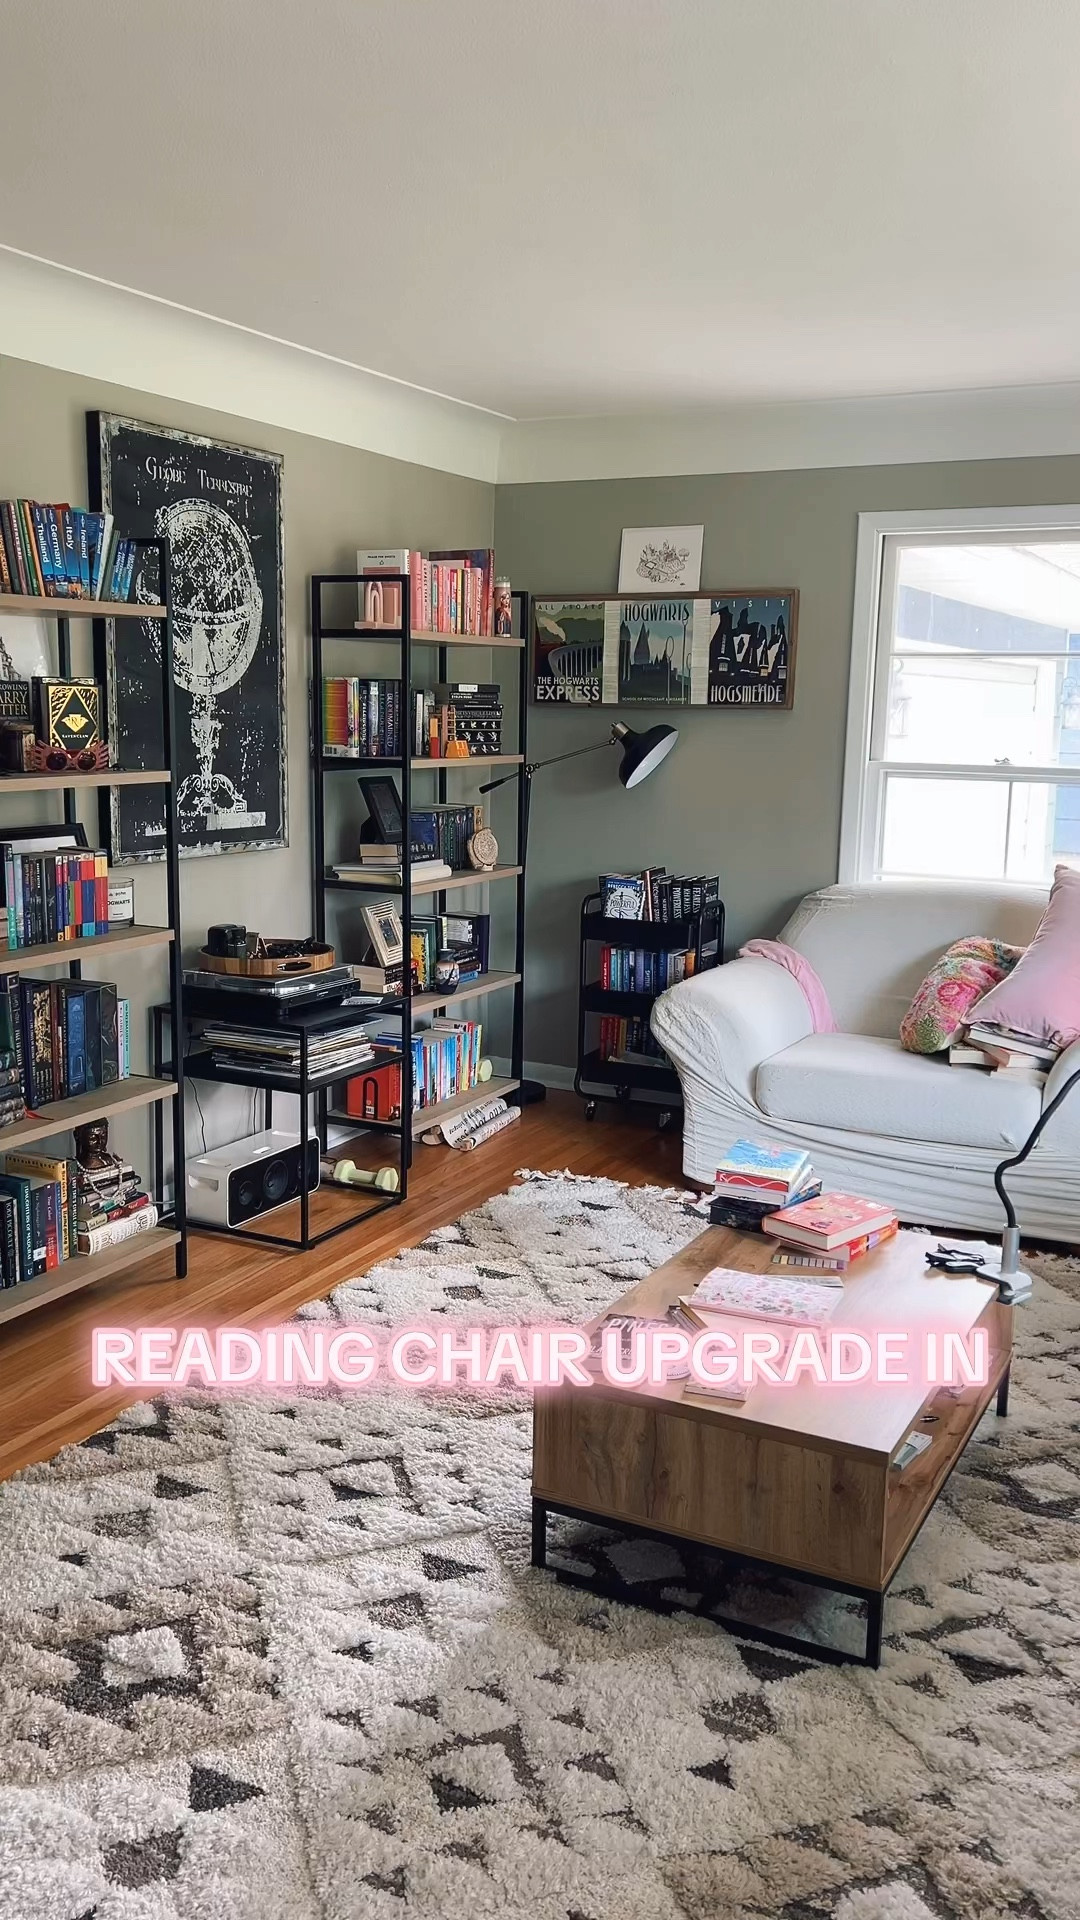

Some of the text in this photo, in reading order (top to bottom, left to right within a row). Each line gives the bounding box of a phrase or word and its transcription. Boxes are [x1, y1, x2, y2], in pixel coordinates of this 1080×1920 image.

[37, 523, 50, 563] Thailand
[50, 524, 62, 568] Germany
[624, 603, 690, 621] HOGWARTS
[715, 600, 785, 608] VISIT
[538, 676, 599, 685] THE HOGWARTS
[536, 685, 600, 700] EXPRESS
[710, 684, 783, 703] HOGSMEADE
[672, 887, 682, 919] POWERLESS
[692, 887, 701, 913] FEARLESS
